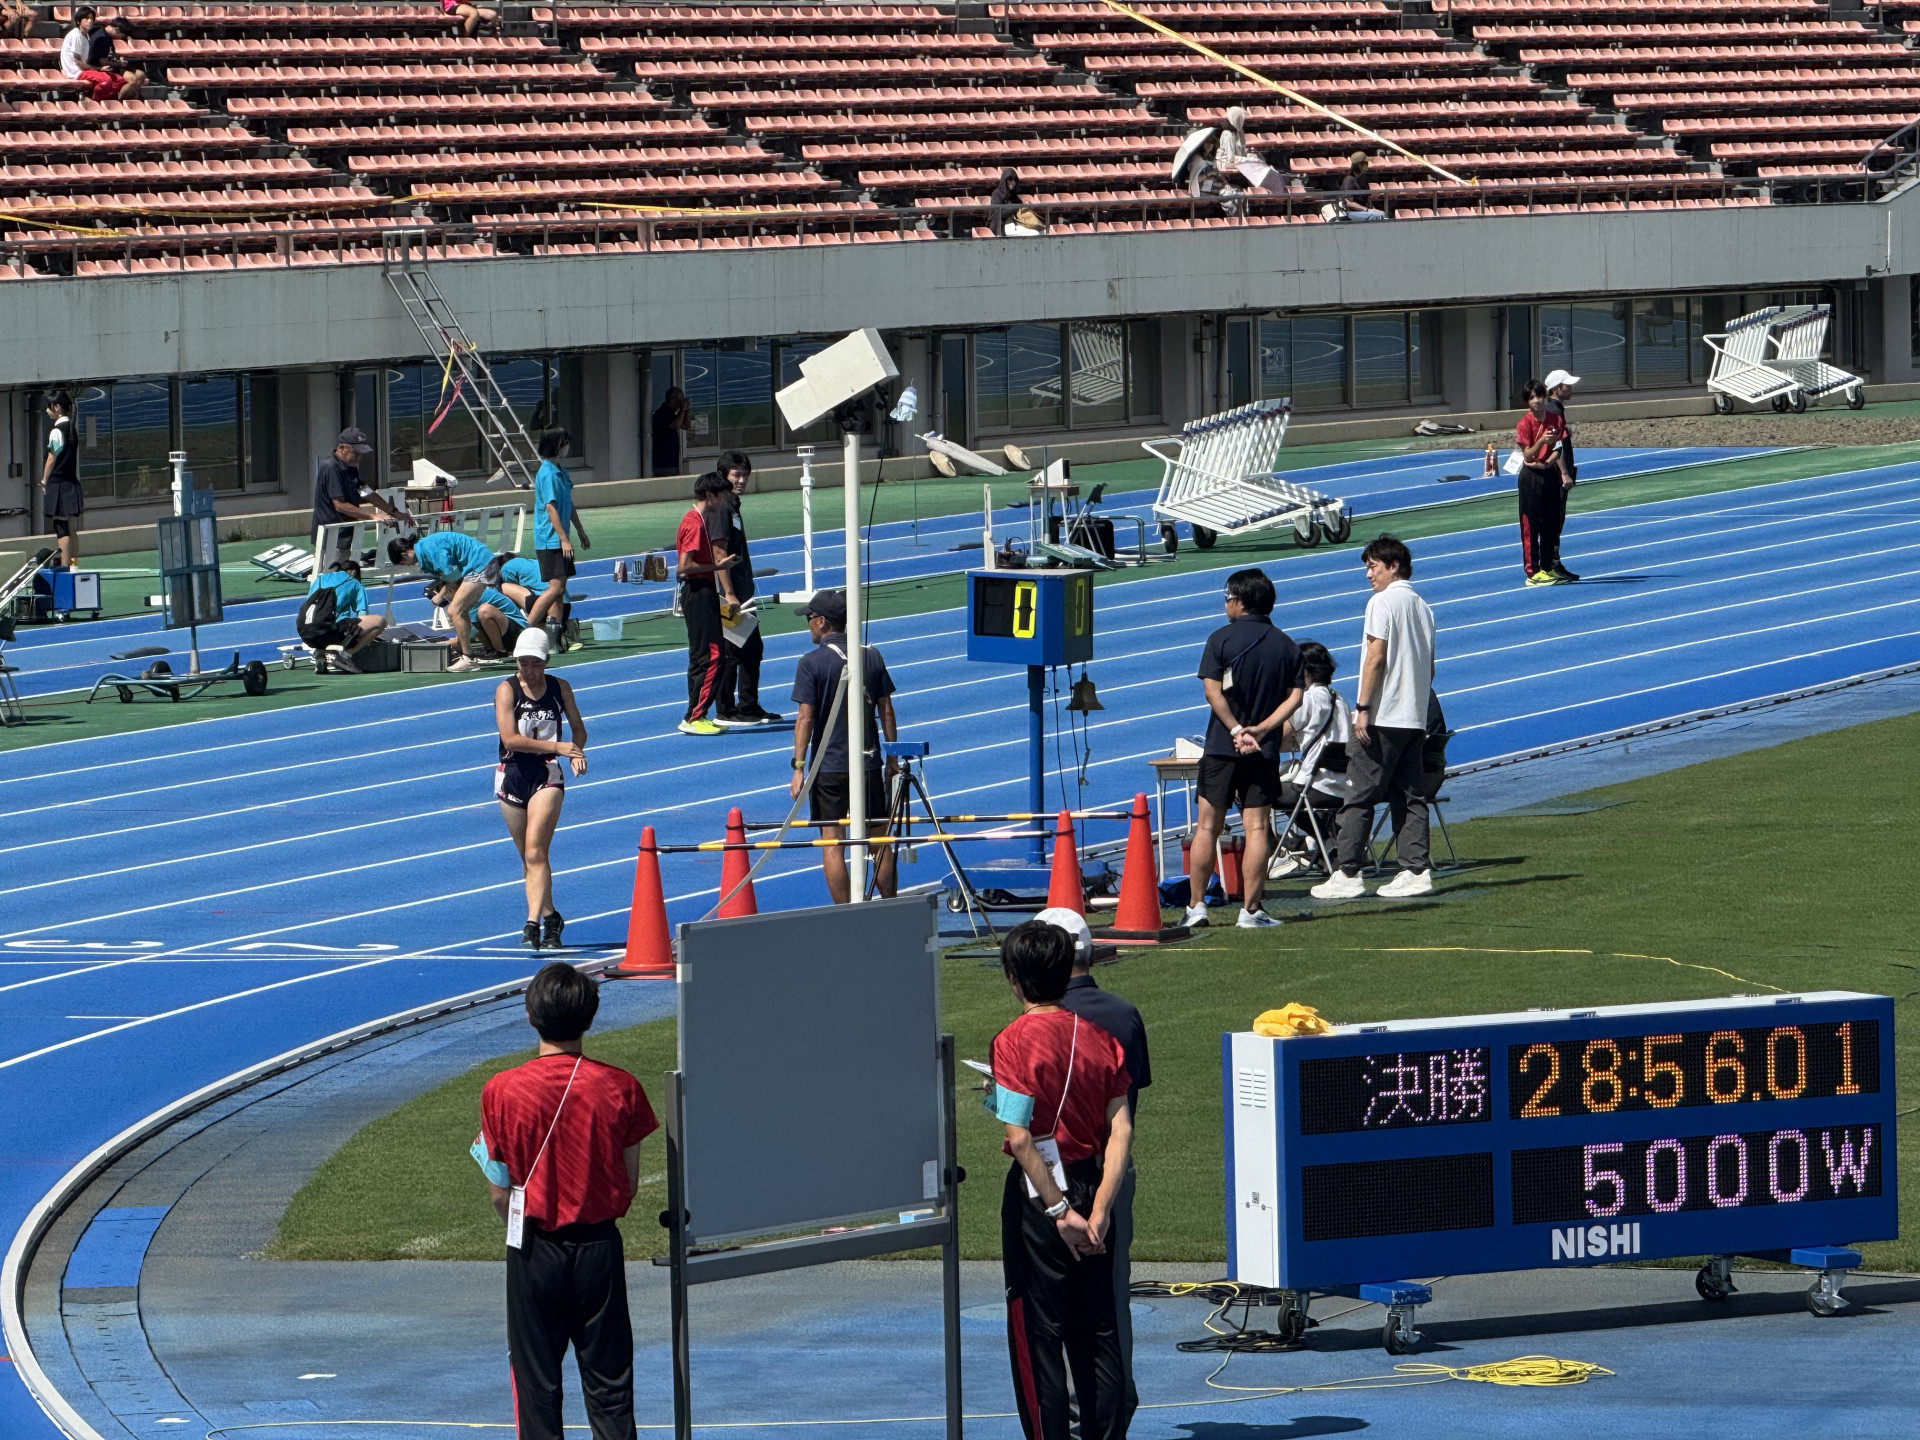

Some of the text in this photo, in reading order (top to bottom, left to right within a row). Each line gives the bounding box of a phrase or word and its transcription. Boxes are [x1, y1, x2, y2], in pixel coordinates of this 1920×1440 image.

[1012, 580, 1037, 639] 0
[1362, 1047, 1487, 1126] 決勝
[1583, 1127, 1873, 1218] 5000W
[1551, 1222, 1641, 1261] NISHI
